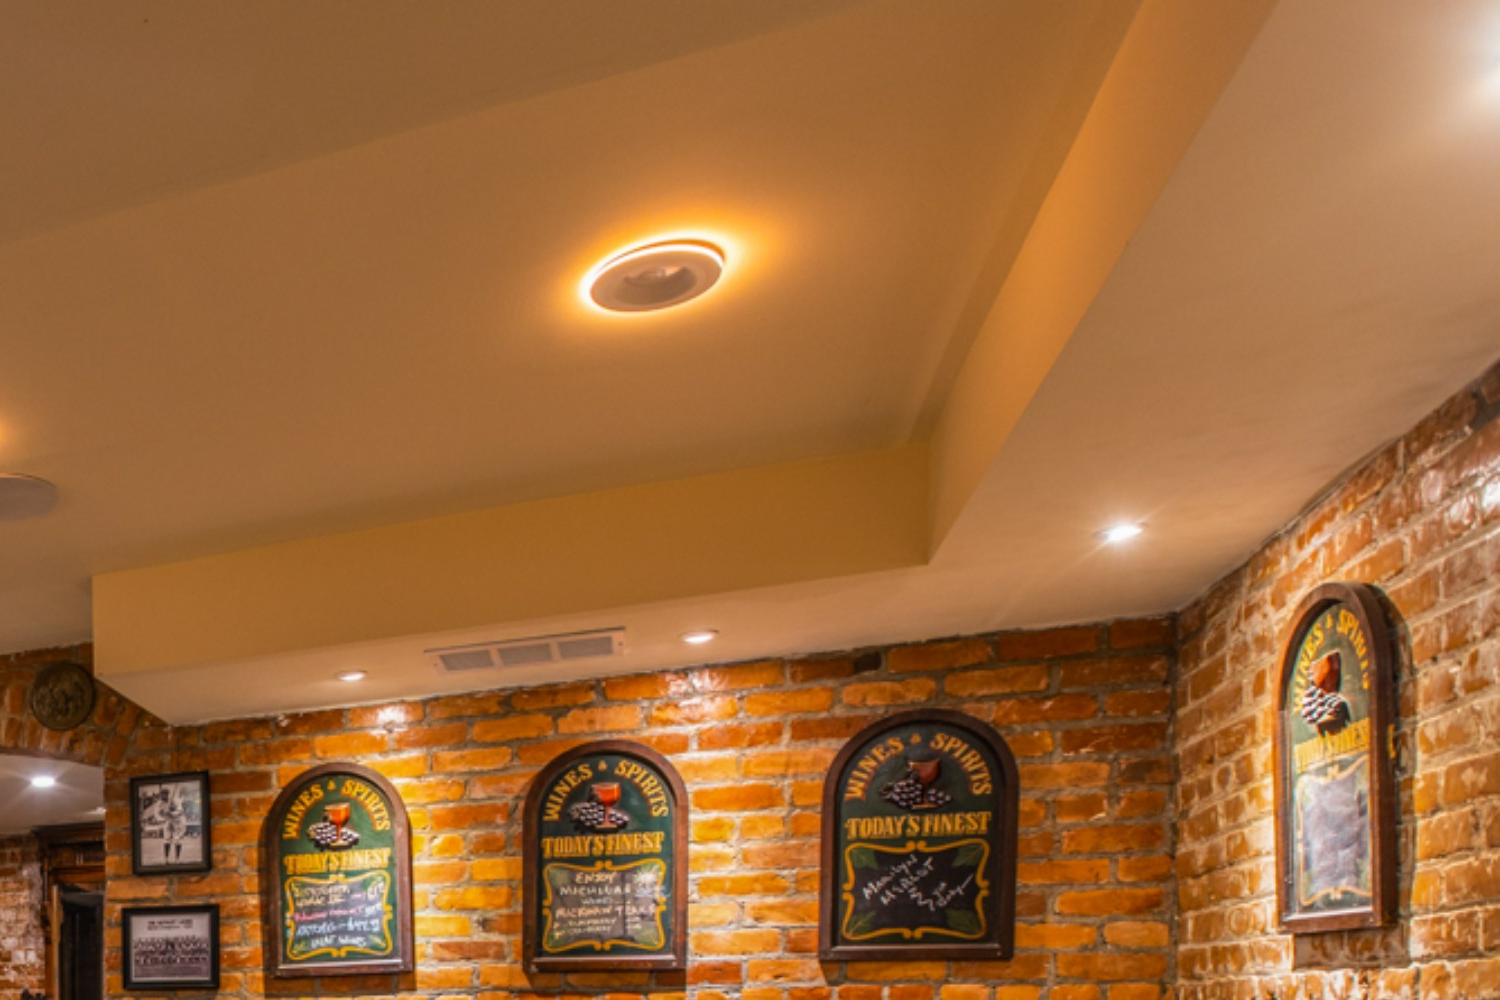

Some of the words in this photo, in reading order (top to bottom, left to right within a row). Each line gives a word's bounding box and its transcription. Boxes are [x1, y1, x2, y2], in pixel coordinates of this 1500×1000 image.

[844, 736, 905, 801] WINES
[930, 732, 993, 795] SPIRITS
[283, 783, 324, 839] WINES
[340, 779, 391, 831] SPIRITS
[543, 763, 593, 822] WINES
[614, 759, 669, 817] SPIRITS
[542, 835, 604, 859] TODAY'S
[605, 831, 665, 856] FINEST
[844, 814, 920, 840] TODAY'S
[921, 811, 992, 837] FINEST
[339, 847, 391, 871] FINEST
